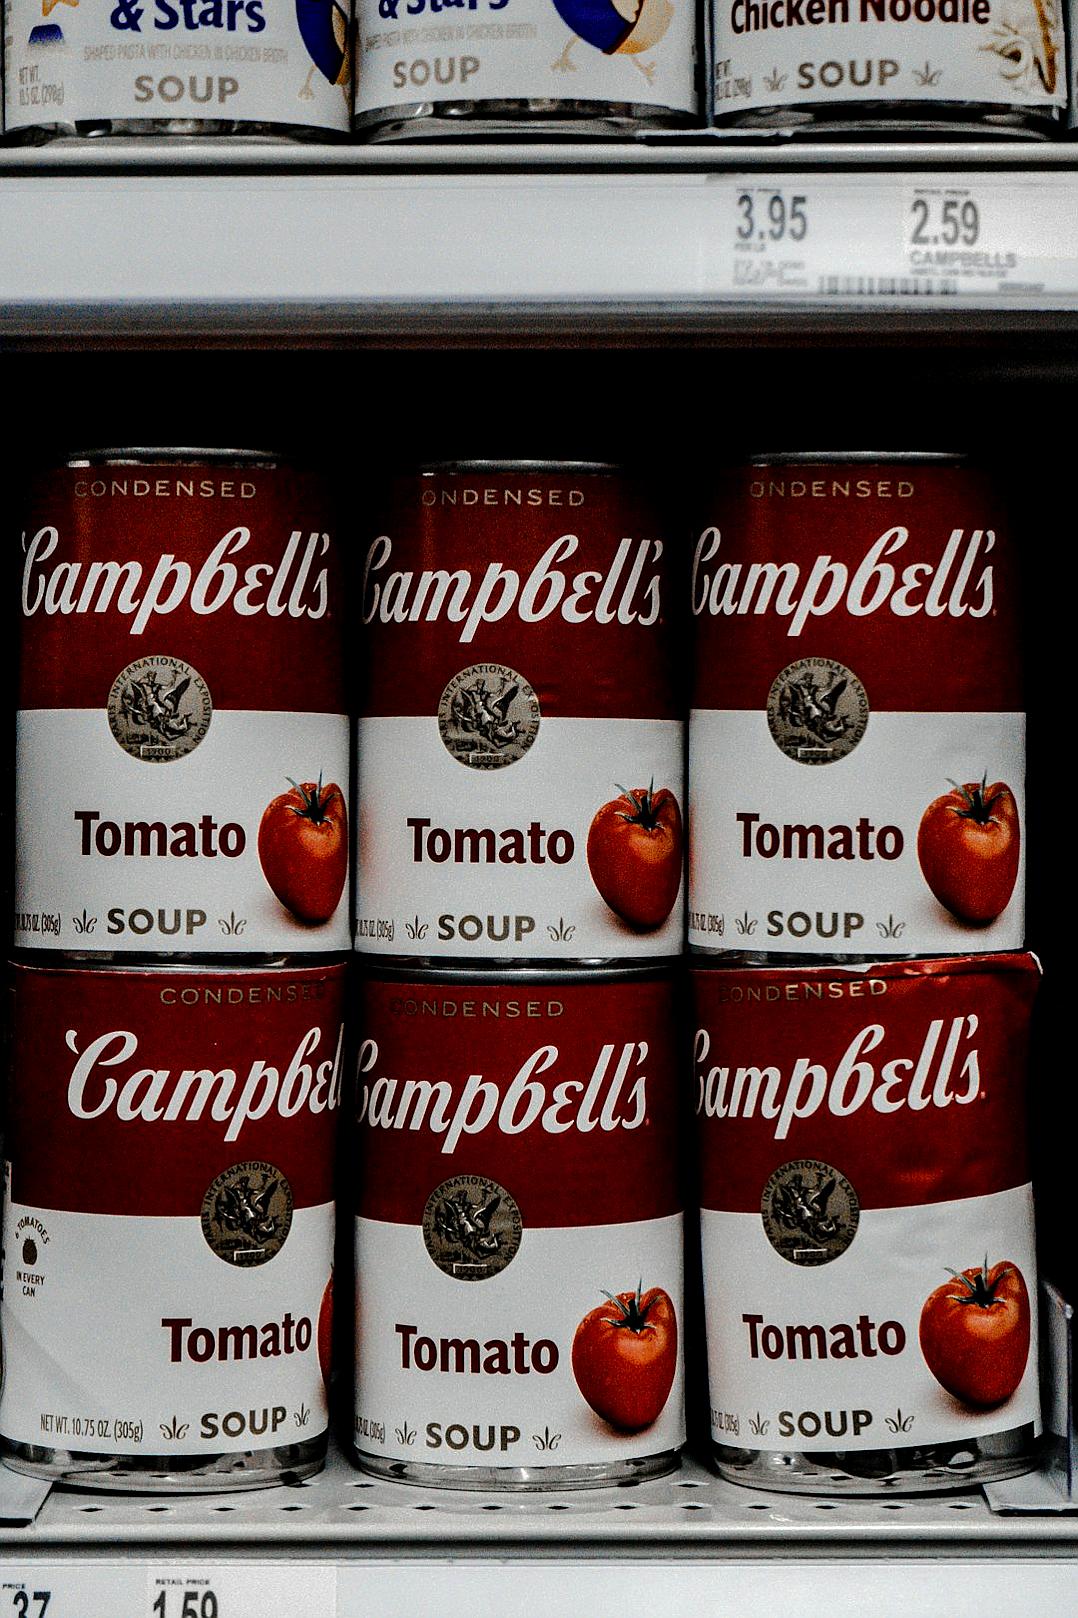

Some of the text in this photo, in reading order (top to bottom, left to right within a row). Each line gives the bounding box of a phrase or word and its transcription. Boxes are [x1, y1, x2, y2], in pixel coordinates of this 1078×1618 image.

[154, 0, 267, 32] Stars
[731, 0, 990, 34] Chicken Noodle
[393, 55, 480, 88] SOUP
[797, 60, 900, 89] SOUP
[134, 75, 240, 104] SOUP
[737, 194, 807, 241] 3.95
[911, 199, 979, 246] 2.59
[74, 480, 257, 498] CONDENSED
[421, 489, 585, 506] ONDENSED
[749, 480, 914, 498] ONDENSED
[22, 526, 331, 635] Campbell's
[362, 534, 664, 643] Campbell's
[692, 526, 996, 636] Campbell's
[74, 811, 246, 857] Tomato
[406, 818, 575, 865] Tomato
[736, 812, 905, 861] Tomato
[107, 907, 207, 935] SOUP
[438, 914, 536, 942] SOUP
[767, 910, 865, 938] SOUP
[160, 985, 322, 1004] CONDENSE
[693, 1013, 982, 1140] Campbell's
[357, 1039, 649, 1154] Campbell's
[17, 1216, 50, 1244] TOMATOES
[22, 1285, 36, 1297] CAN
[23, 1272, 45, 1286] EVERY
[161, 1312, 312, 1363] Tomato
[395, 1323, 559, 1374] Tomato
[742, 1313, 906, 1360] Tomato
[40, 1414, 53, 1432] NET
[55, 1415, 70, 1434] WT.
[72, 1417, 95, 1437] 10.75
[114, 1418, 143, 1442] (305g)
[200, 1406, 287, 1439] SOUP
[426, 1422, 521, 1451] SOUP
[778, 1410, 874, 1437] SOUP
[153, 1590, 219, 1618] 159
